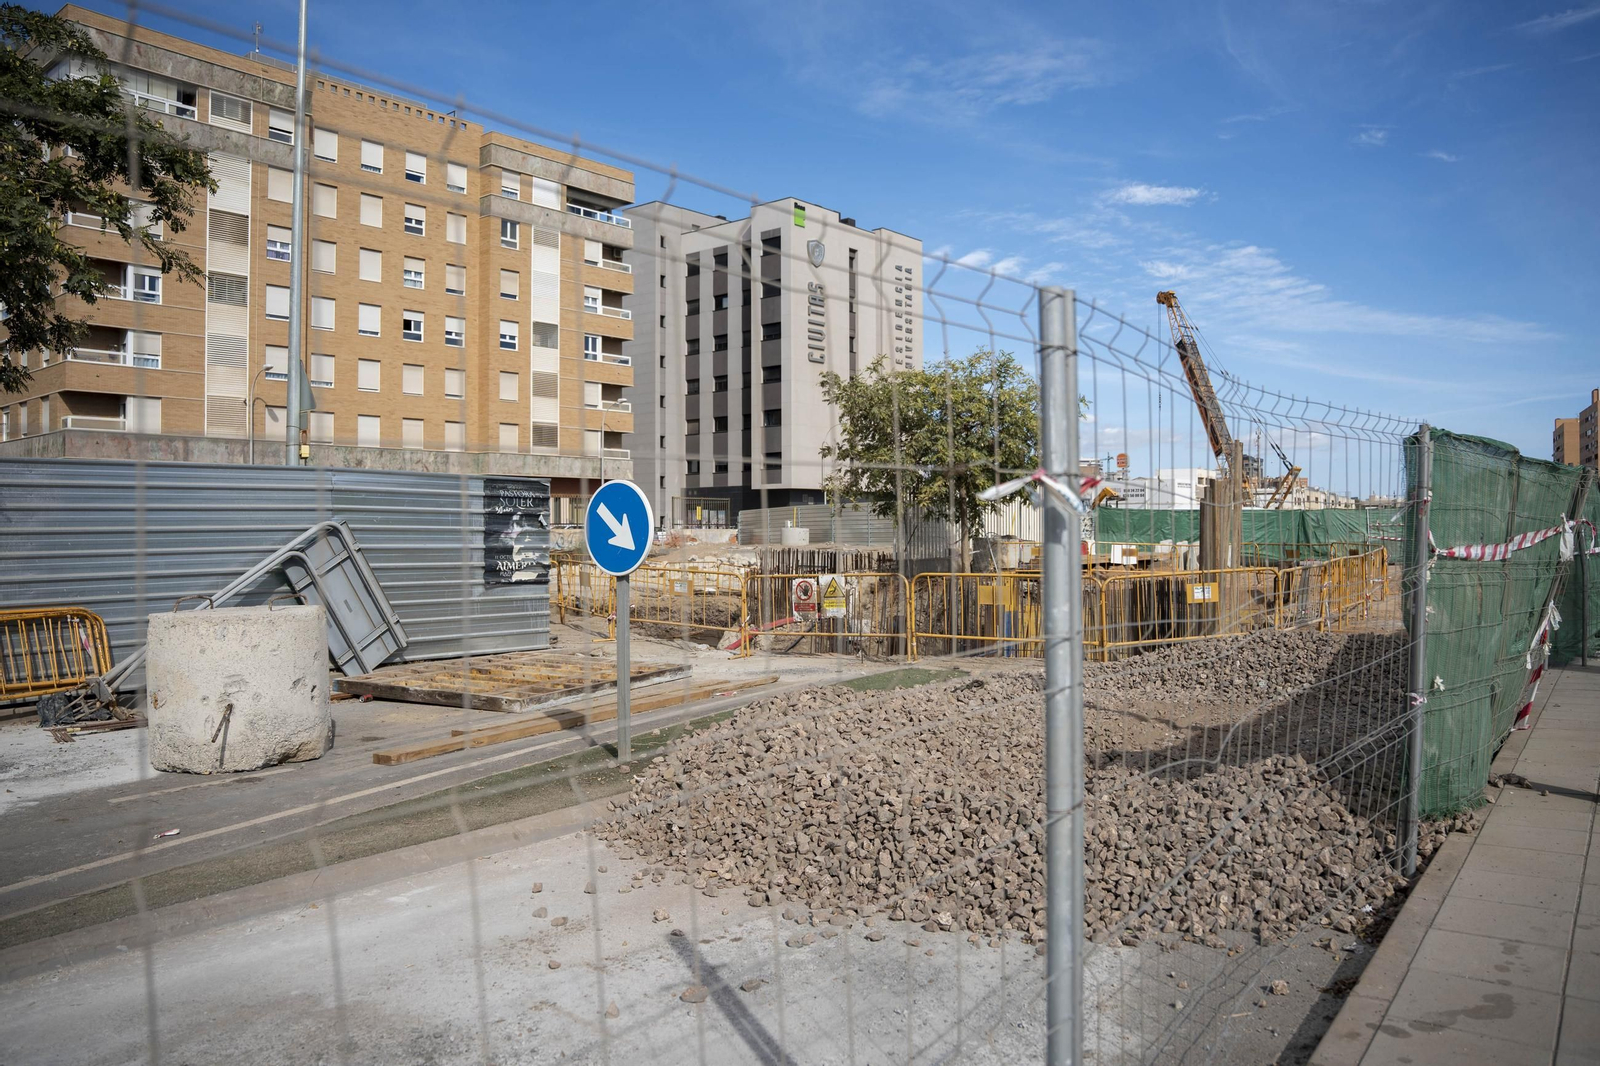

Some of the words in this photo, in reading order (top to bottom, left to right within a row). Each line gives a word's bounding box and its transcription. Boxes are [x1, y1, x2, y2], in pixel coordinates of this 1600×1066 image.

[807, 281, 826, 365] CIVITAS
[894, 265, 903, 366] ESIDENCIA
[904, 267, 913, 370] NIVERSITARIA
[499, 489, 536, 498] PASTORA
[499, 497, 534, 509] SOLER
